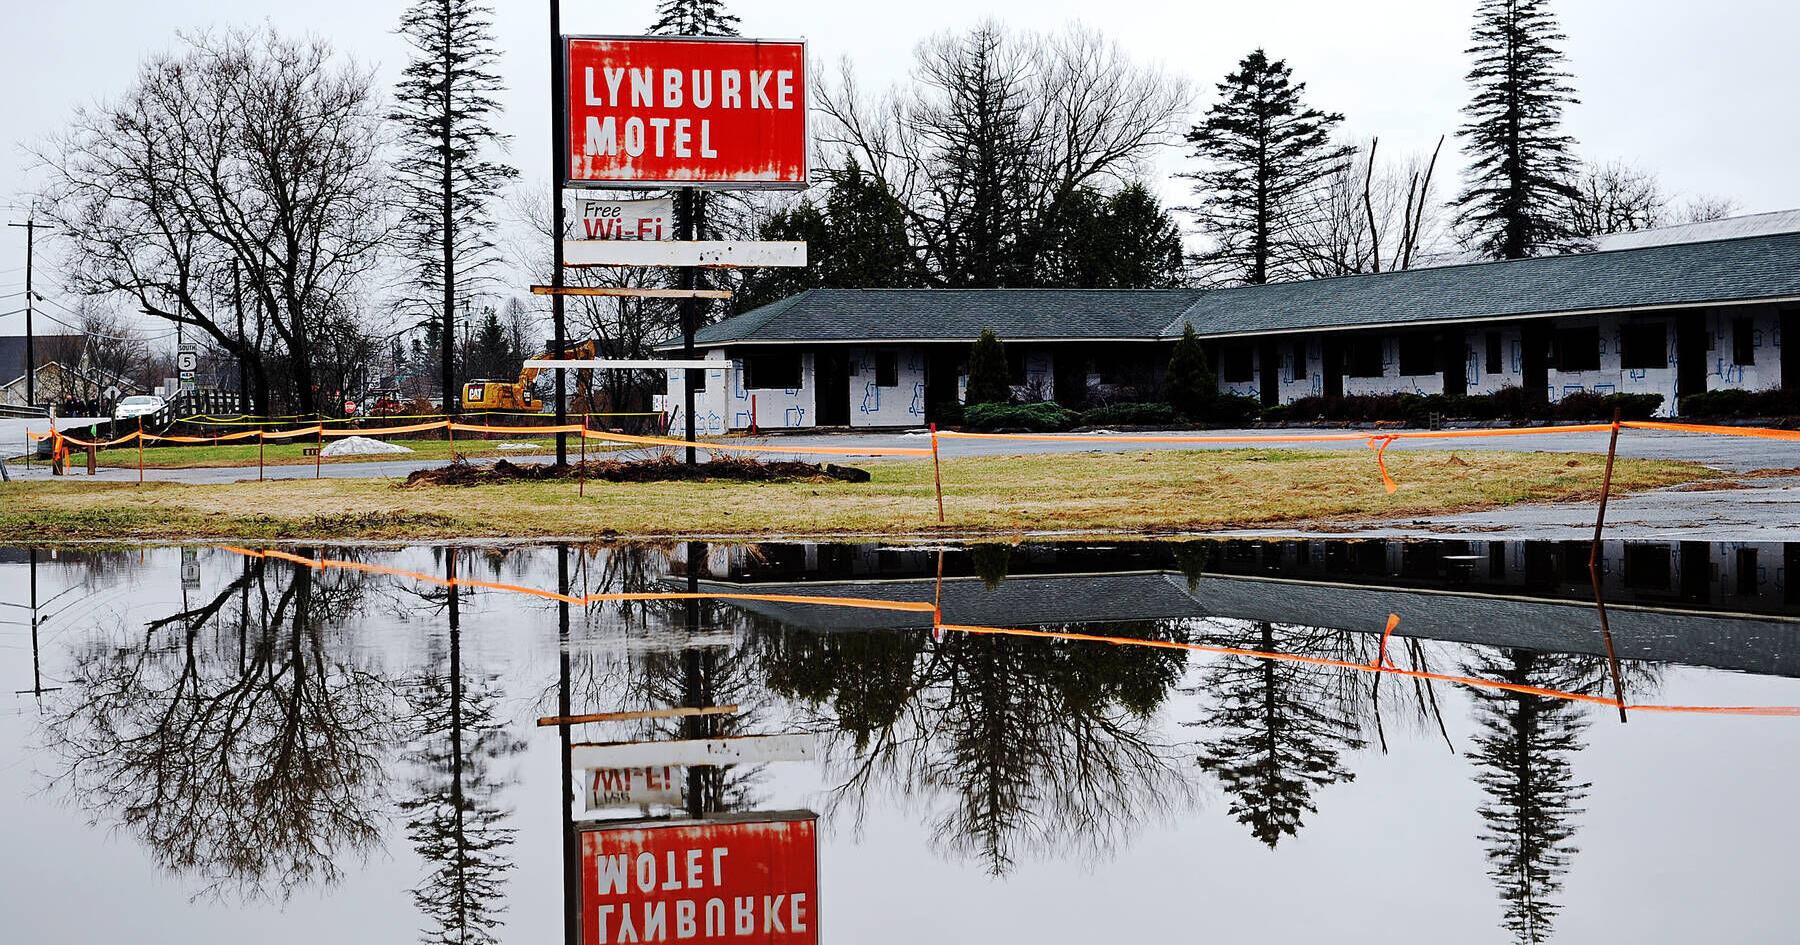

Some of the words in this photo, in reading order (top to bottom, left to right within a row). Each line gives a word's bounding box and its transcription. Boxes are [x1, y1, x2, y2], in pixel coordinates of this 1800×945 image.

[585, 67, 793, 109] LYNBURKE
[586, 116, 717, 158] MOTEL
[584, 202, 621, 217] Free
[583, 217, 662, 240] Wi-Fi
[184, 357, 191, 367] 5
[468, 388, 483, 400] CAT
